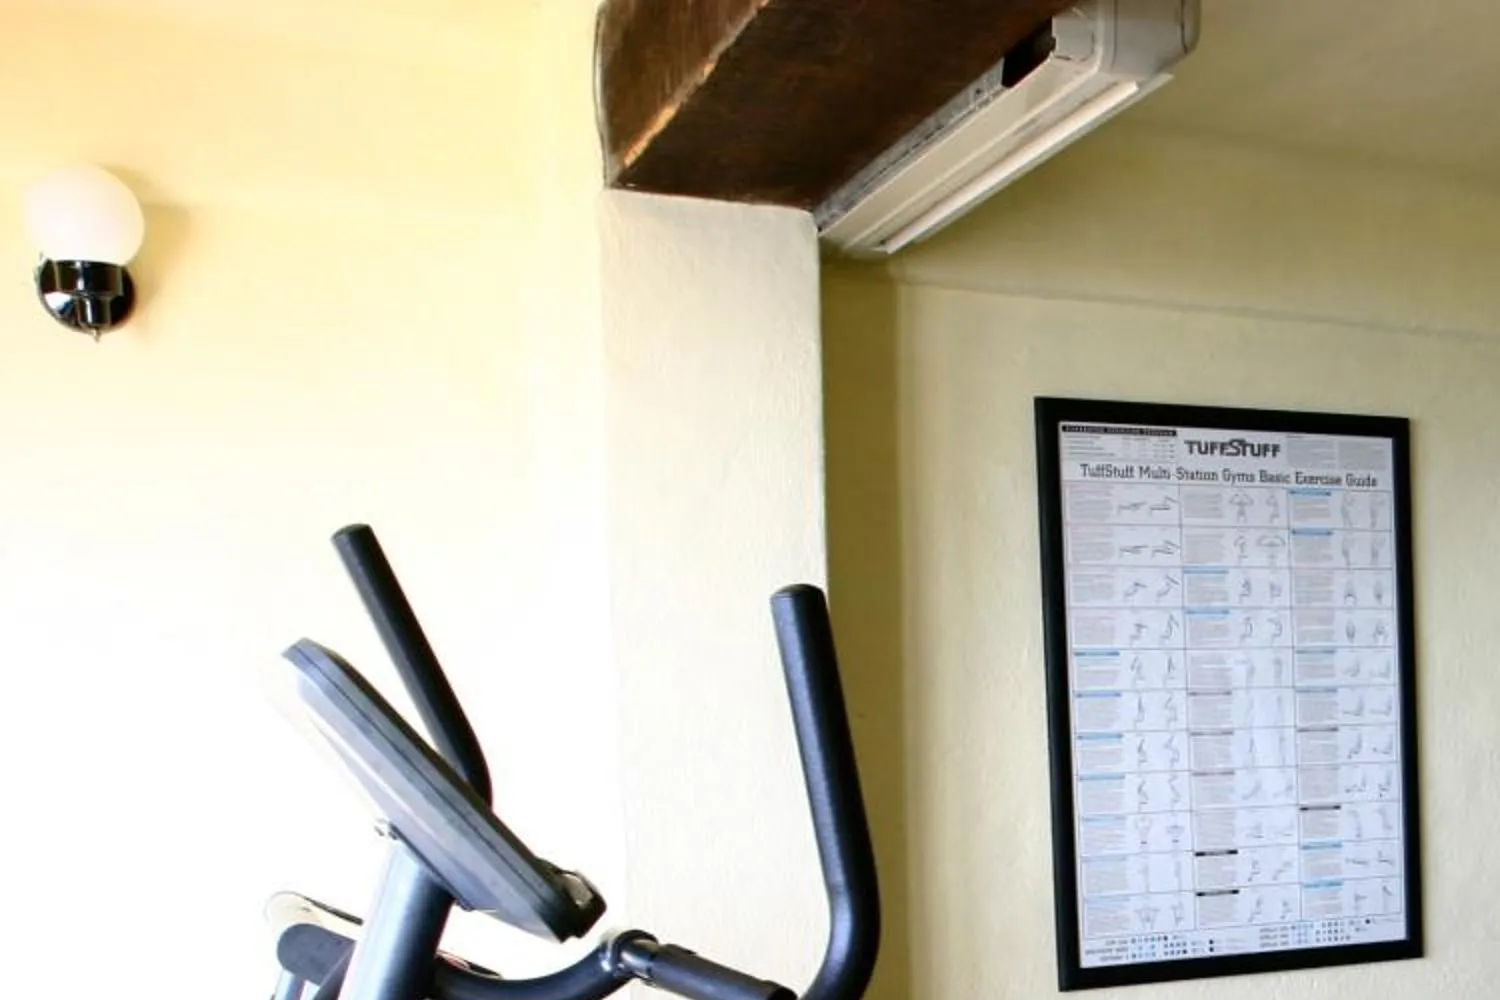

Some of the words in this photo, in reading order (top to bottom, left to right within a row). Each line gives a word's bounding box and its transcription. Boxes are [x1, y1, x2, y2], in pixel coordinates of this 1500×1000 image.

[1184, 439, 1281, 458] TUFFSTUFF
[1080, 463, 1135, 479] TuffStuff
[1259, 469, 1291, 484] Basic
[1295, 471, 1343, 486] Exercise
[1345, 473, 1378, 488] Guide
